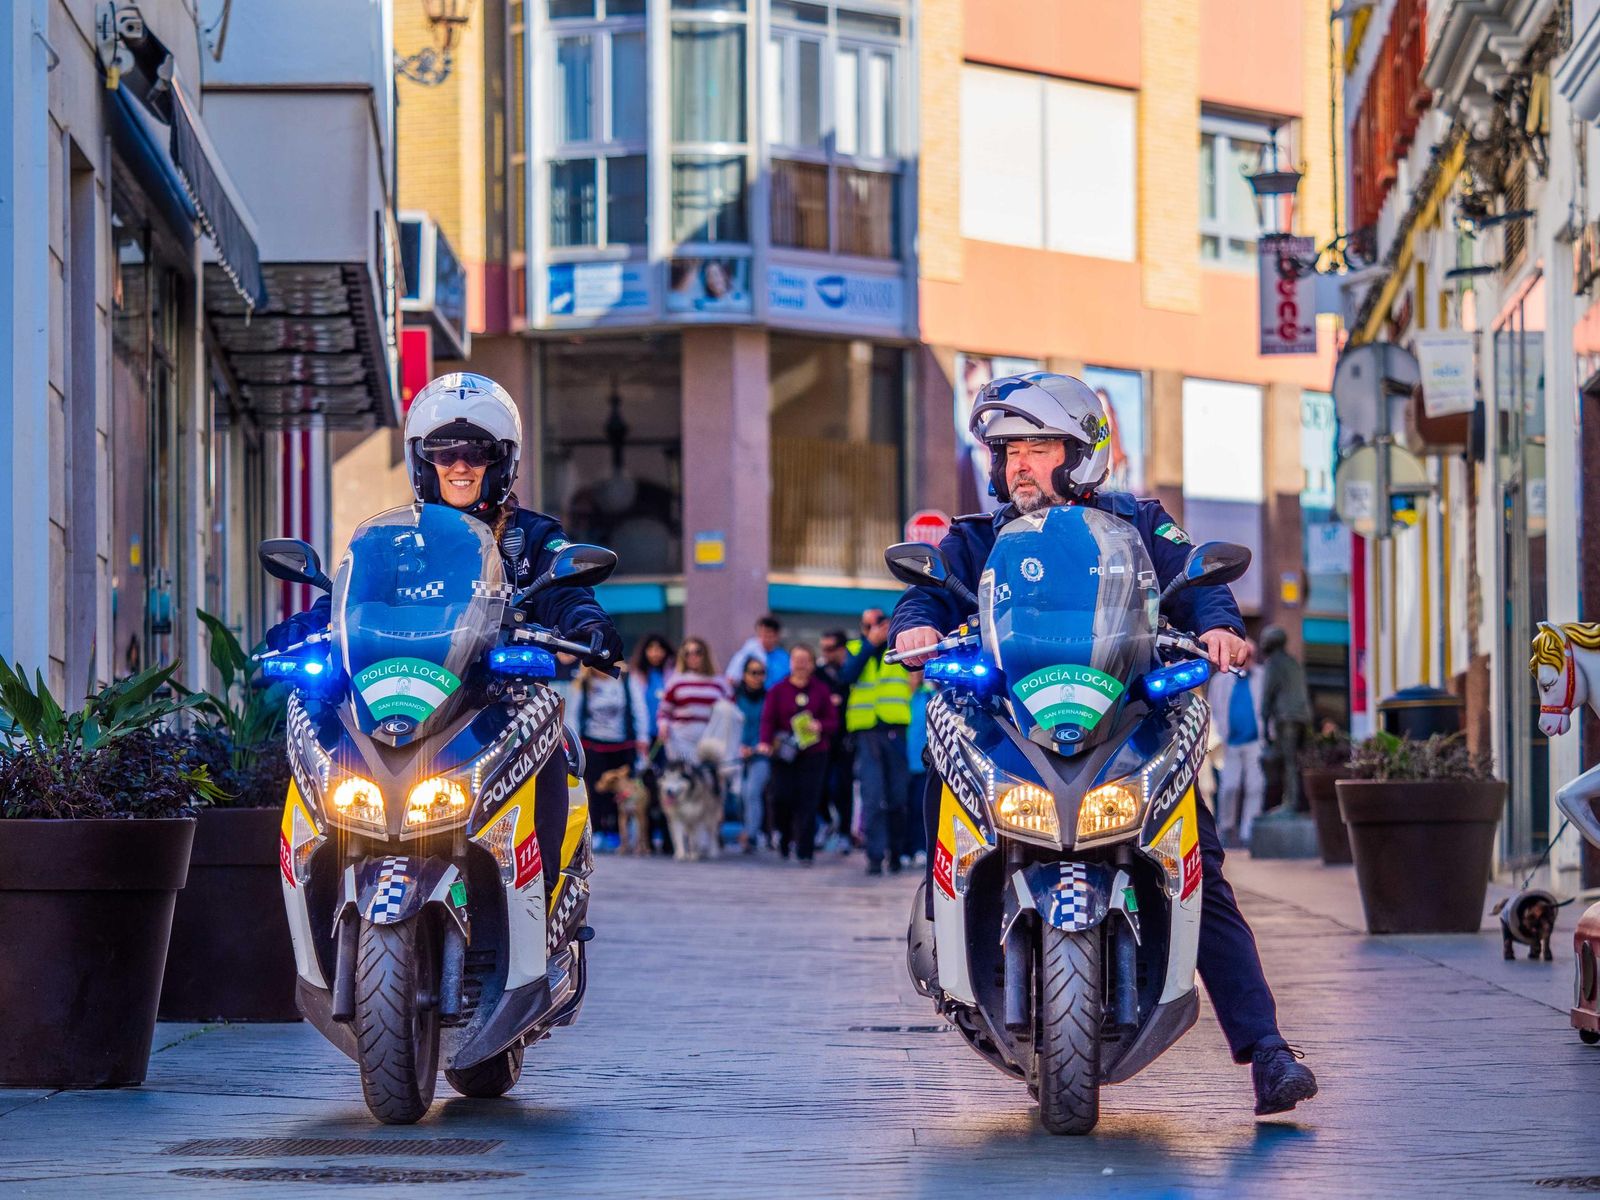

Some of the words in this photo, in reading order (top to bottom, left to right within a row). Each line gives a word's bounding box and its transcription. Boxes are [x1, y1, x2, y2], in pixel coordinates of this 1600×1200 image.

[361, 662, 409, 684] POLICÍA
[413, 665, 451, 688] LOCAL
[1021, 669, 1070, 693] POLICÍA
[1075, 671, 1114, 693] LOCAL
[378, 702, 390, 711] SAN
[391, 701, 426, 712] FERNANDO
[1043, 711, 1057, 720] SAN
[1058, 709, 1093, 719] FERNANDO
[482, 753, 535, 812] POLICÍA
[947, 765, 983, 820] LOCAL
[519, 836, 539, 868] 112
[936, 847, 951, 879] 112
[1186, 844, 1200, 877] 112
